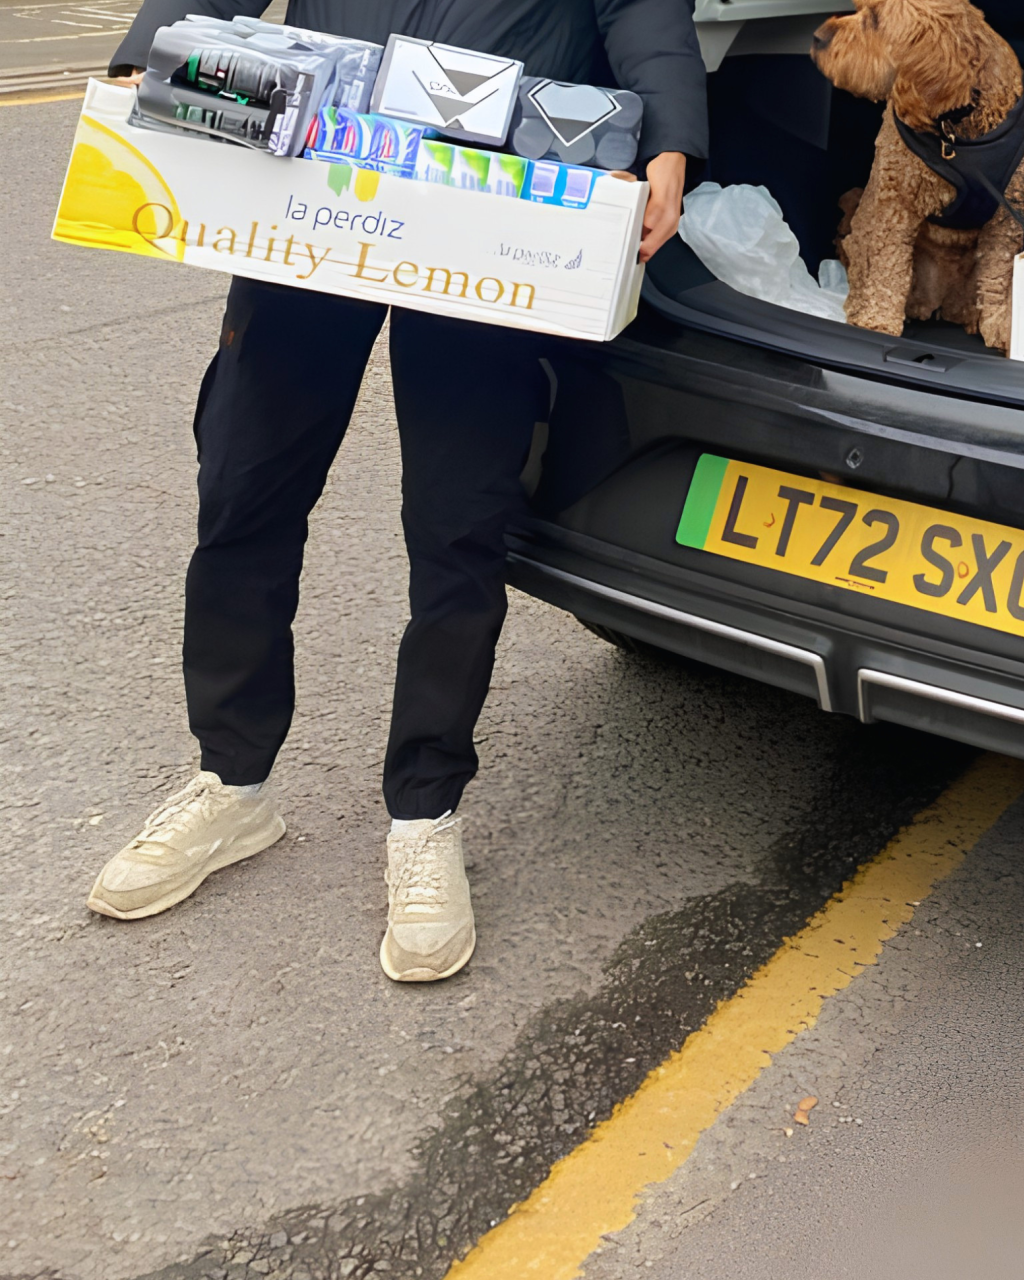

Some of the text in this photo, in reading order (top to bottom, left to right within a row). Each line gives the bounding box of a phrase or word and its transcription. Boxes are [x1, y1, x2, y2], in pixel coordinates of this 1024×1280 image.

[132, 202, 333, 280] Quality
[347, 240, 537, 310] Lemon
[285, 194, 406, 240] la perdiz
[720, 474, 901, 585] LT72
